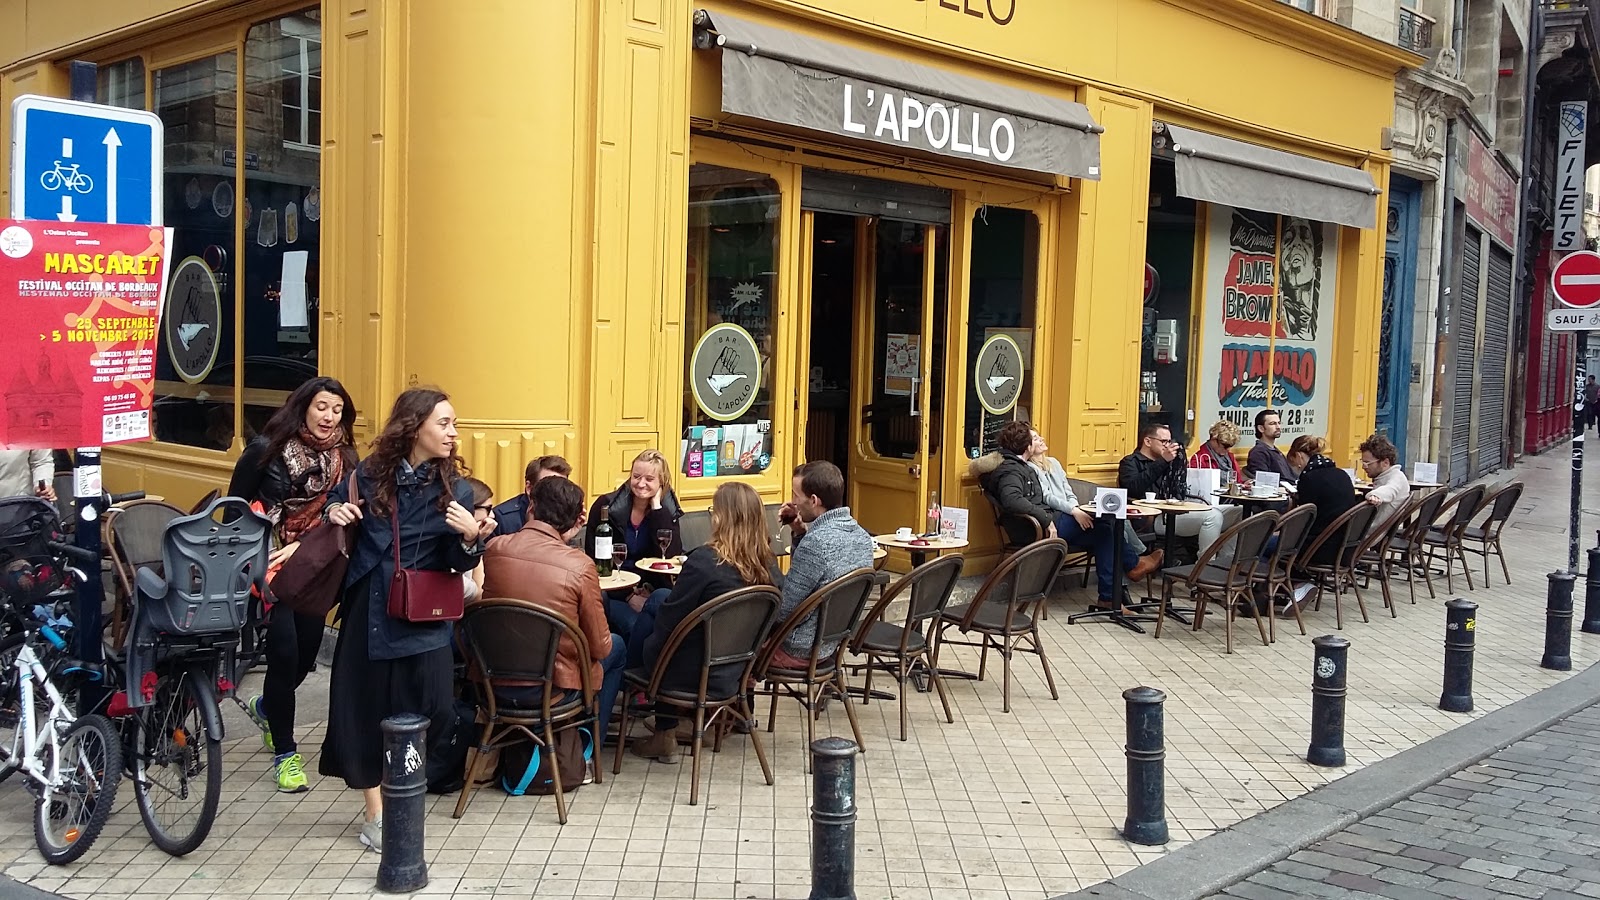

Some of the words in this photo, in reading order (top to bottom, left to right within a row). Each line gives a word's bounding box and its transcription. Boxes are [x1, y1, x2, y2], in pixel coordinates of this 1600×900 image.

[843, 84, 1015, 162] L'APOLLO
[1557, 140, 1581, 248] FILETS
[44, 252, 160, 275] MASCARET
[18, 278, 63, 290] FESTIVAL
[65, 278, 103, 291] OCCITAN
[105, 281, 117, 291] DE
[119, 282, 158, 292] BORDEAUX
[76, 318, 92, 330] 29
[98, 317, 155, 329] SEPTEMBRE
[1555, 315, 1585, 324] SAUF
[52, 332, 62, 342] 5
[67, 330, 128, 342] NOVEMBRE
[131, 329, 155, 341] 2017
[718, 336, 738, 344] BAR
[1249, 350, 1315, 391] APOLLO
[717, 384, 751, 410] L'APOLLO
[993, 384, 1016, 406] L'APOLLO
[1238, 376, 1288, 402] Theatre
[1218, 410, 1253, 428] THUR.
[1287, 409, 1301, 426] 28
